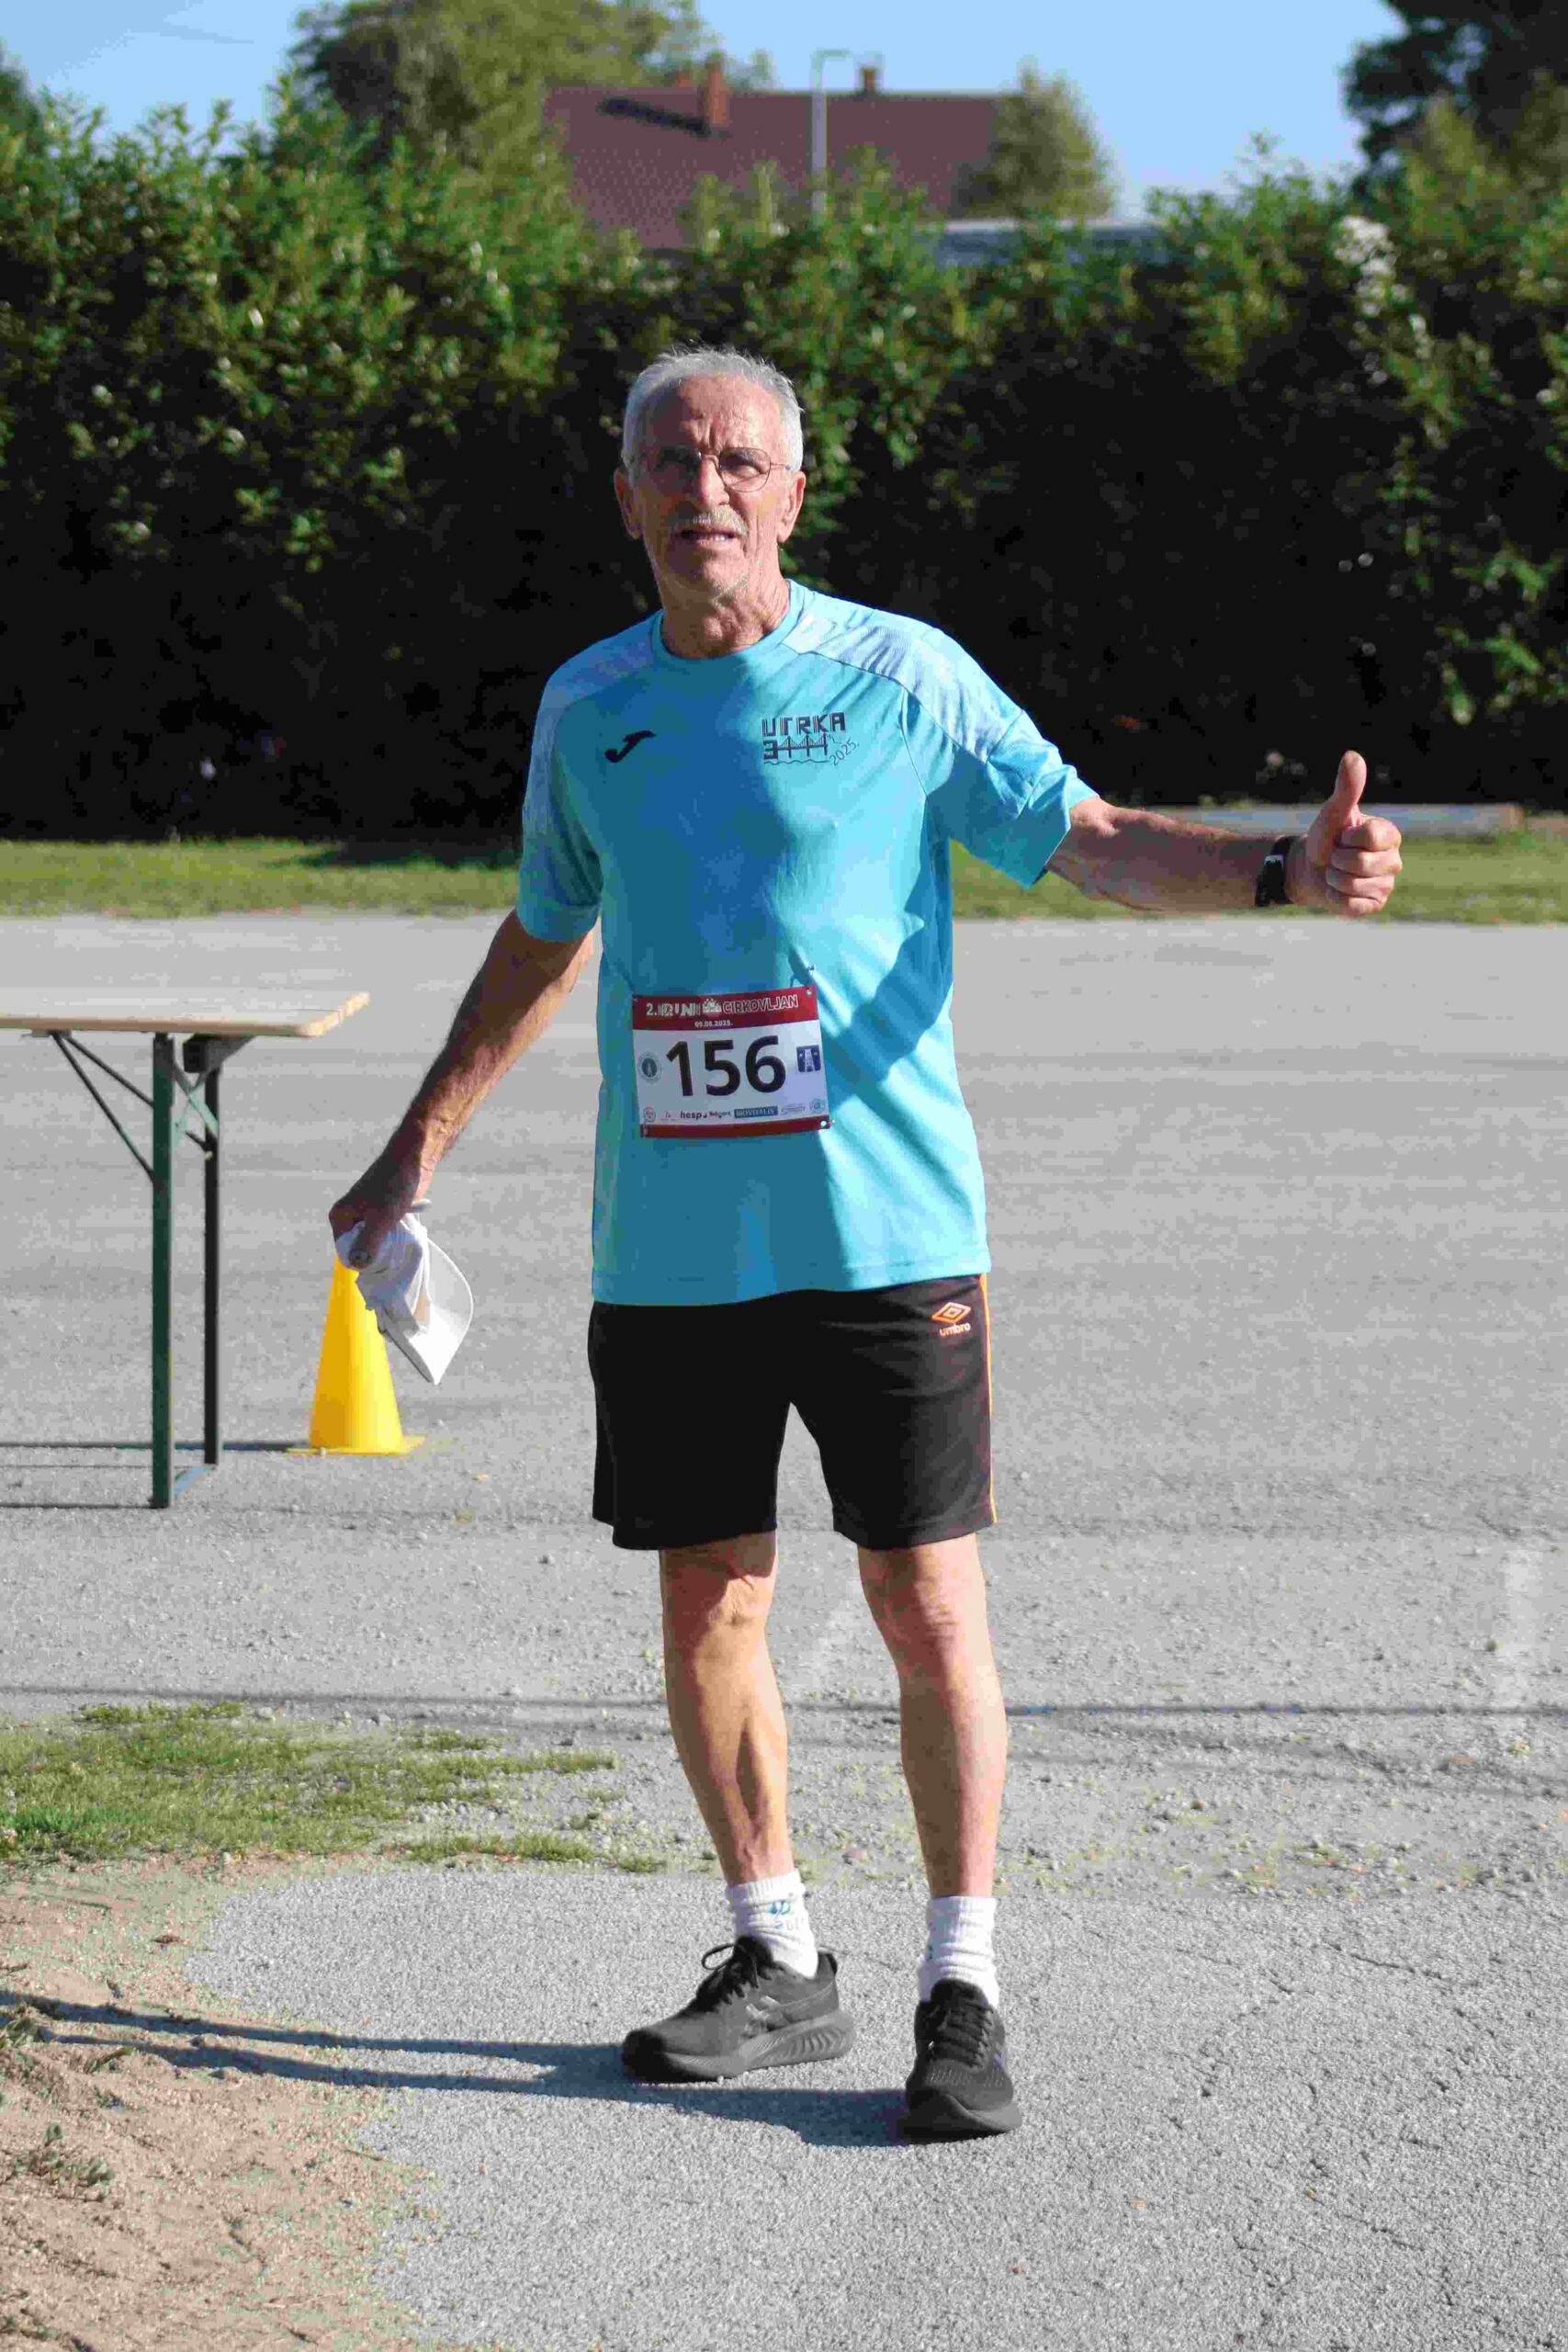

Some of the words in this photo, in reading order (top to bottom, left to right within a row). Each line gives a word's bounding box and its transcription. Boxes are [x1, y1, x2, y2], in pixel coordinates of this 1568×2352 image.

[722, 994, 799, 1014] CIRKOVLJAN
[666, 1035, 786, 1097] 156
[940, 1323, 971, 1337] umbro
